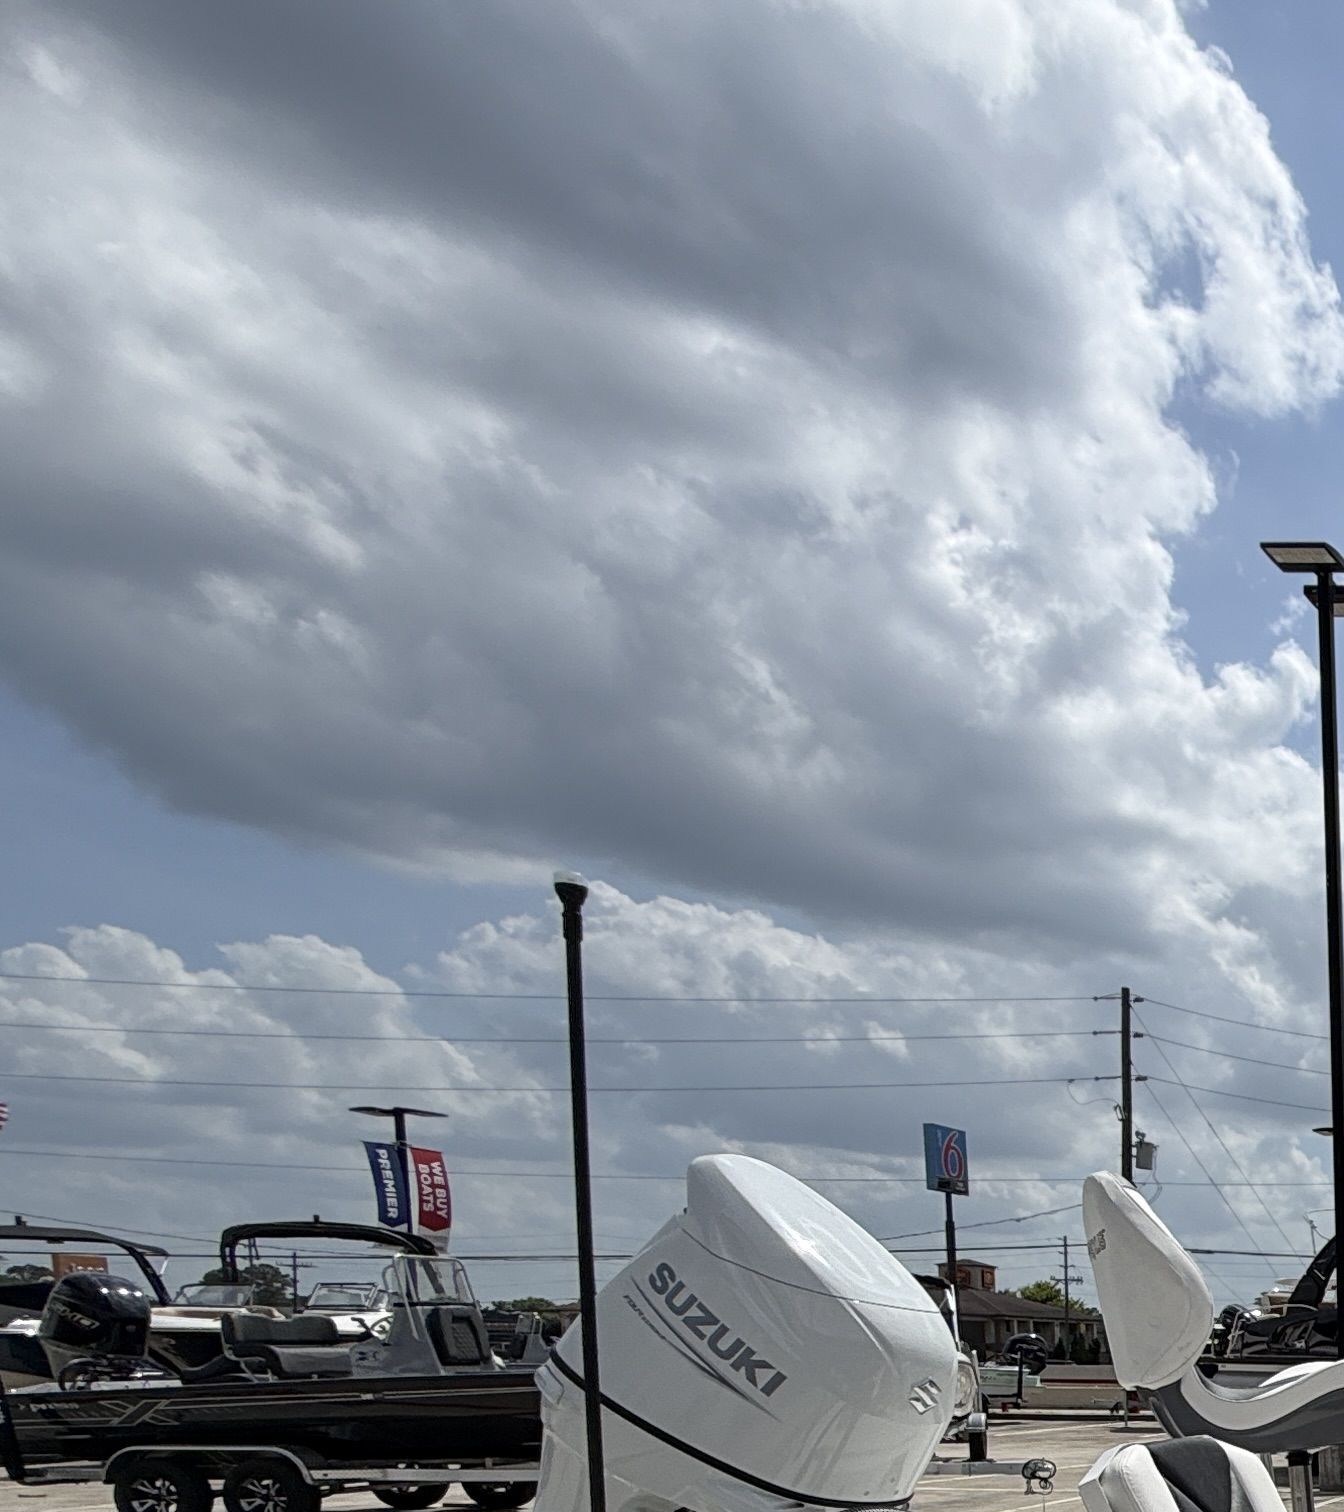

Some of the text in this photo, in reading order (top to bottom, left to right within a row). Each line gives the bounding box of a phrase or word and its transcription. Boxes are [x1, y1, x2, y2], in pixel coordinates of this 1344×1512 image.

[375, 1148, 399, 1219] PREMIER
[941, 1130, 964, 1181] 6
[418, 1163, 434, 1212] BOATS
[430, 1161, 449, 1219] WE BUY
[648, 1262, 788, 1397] SUZUKI
